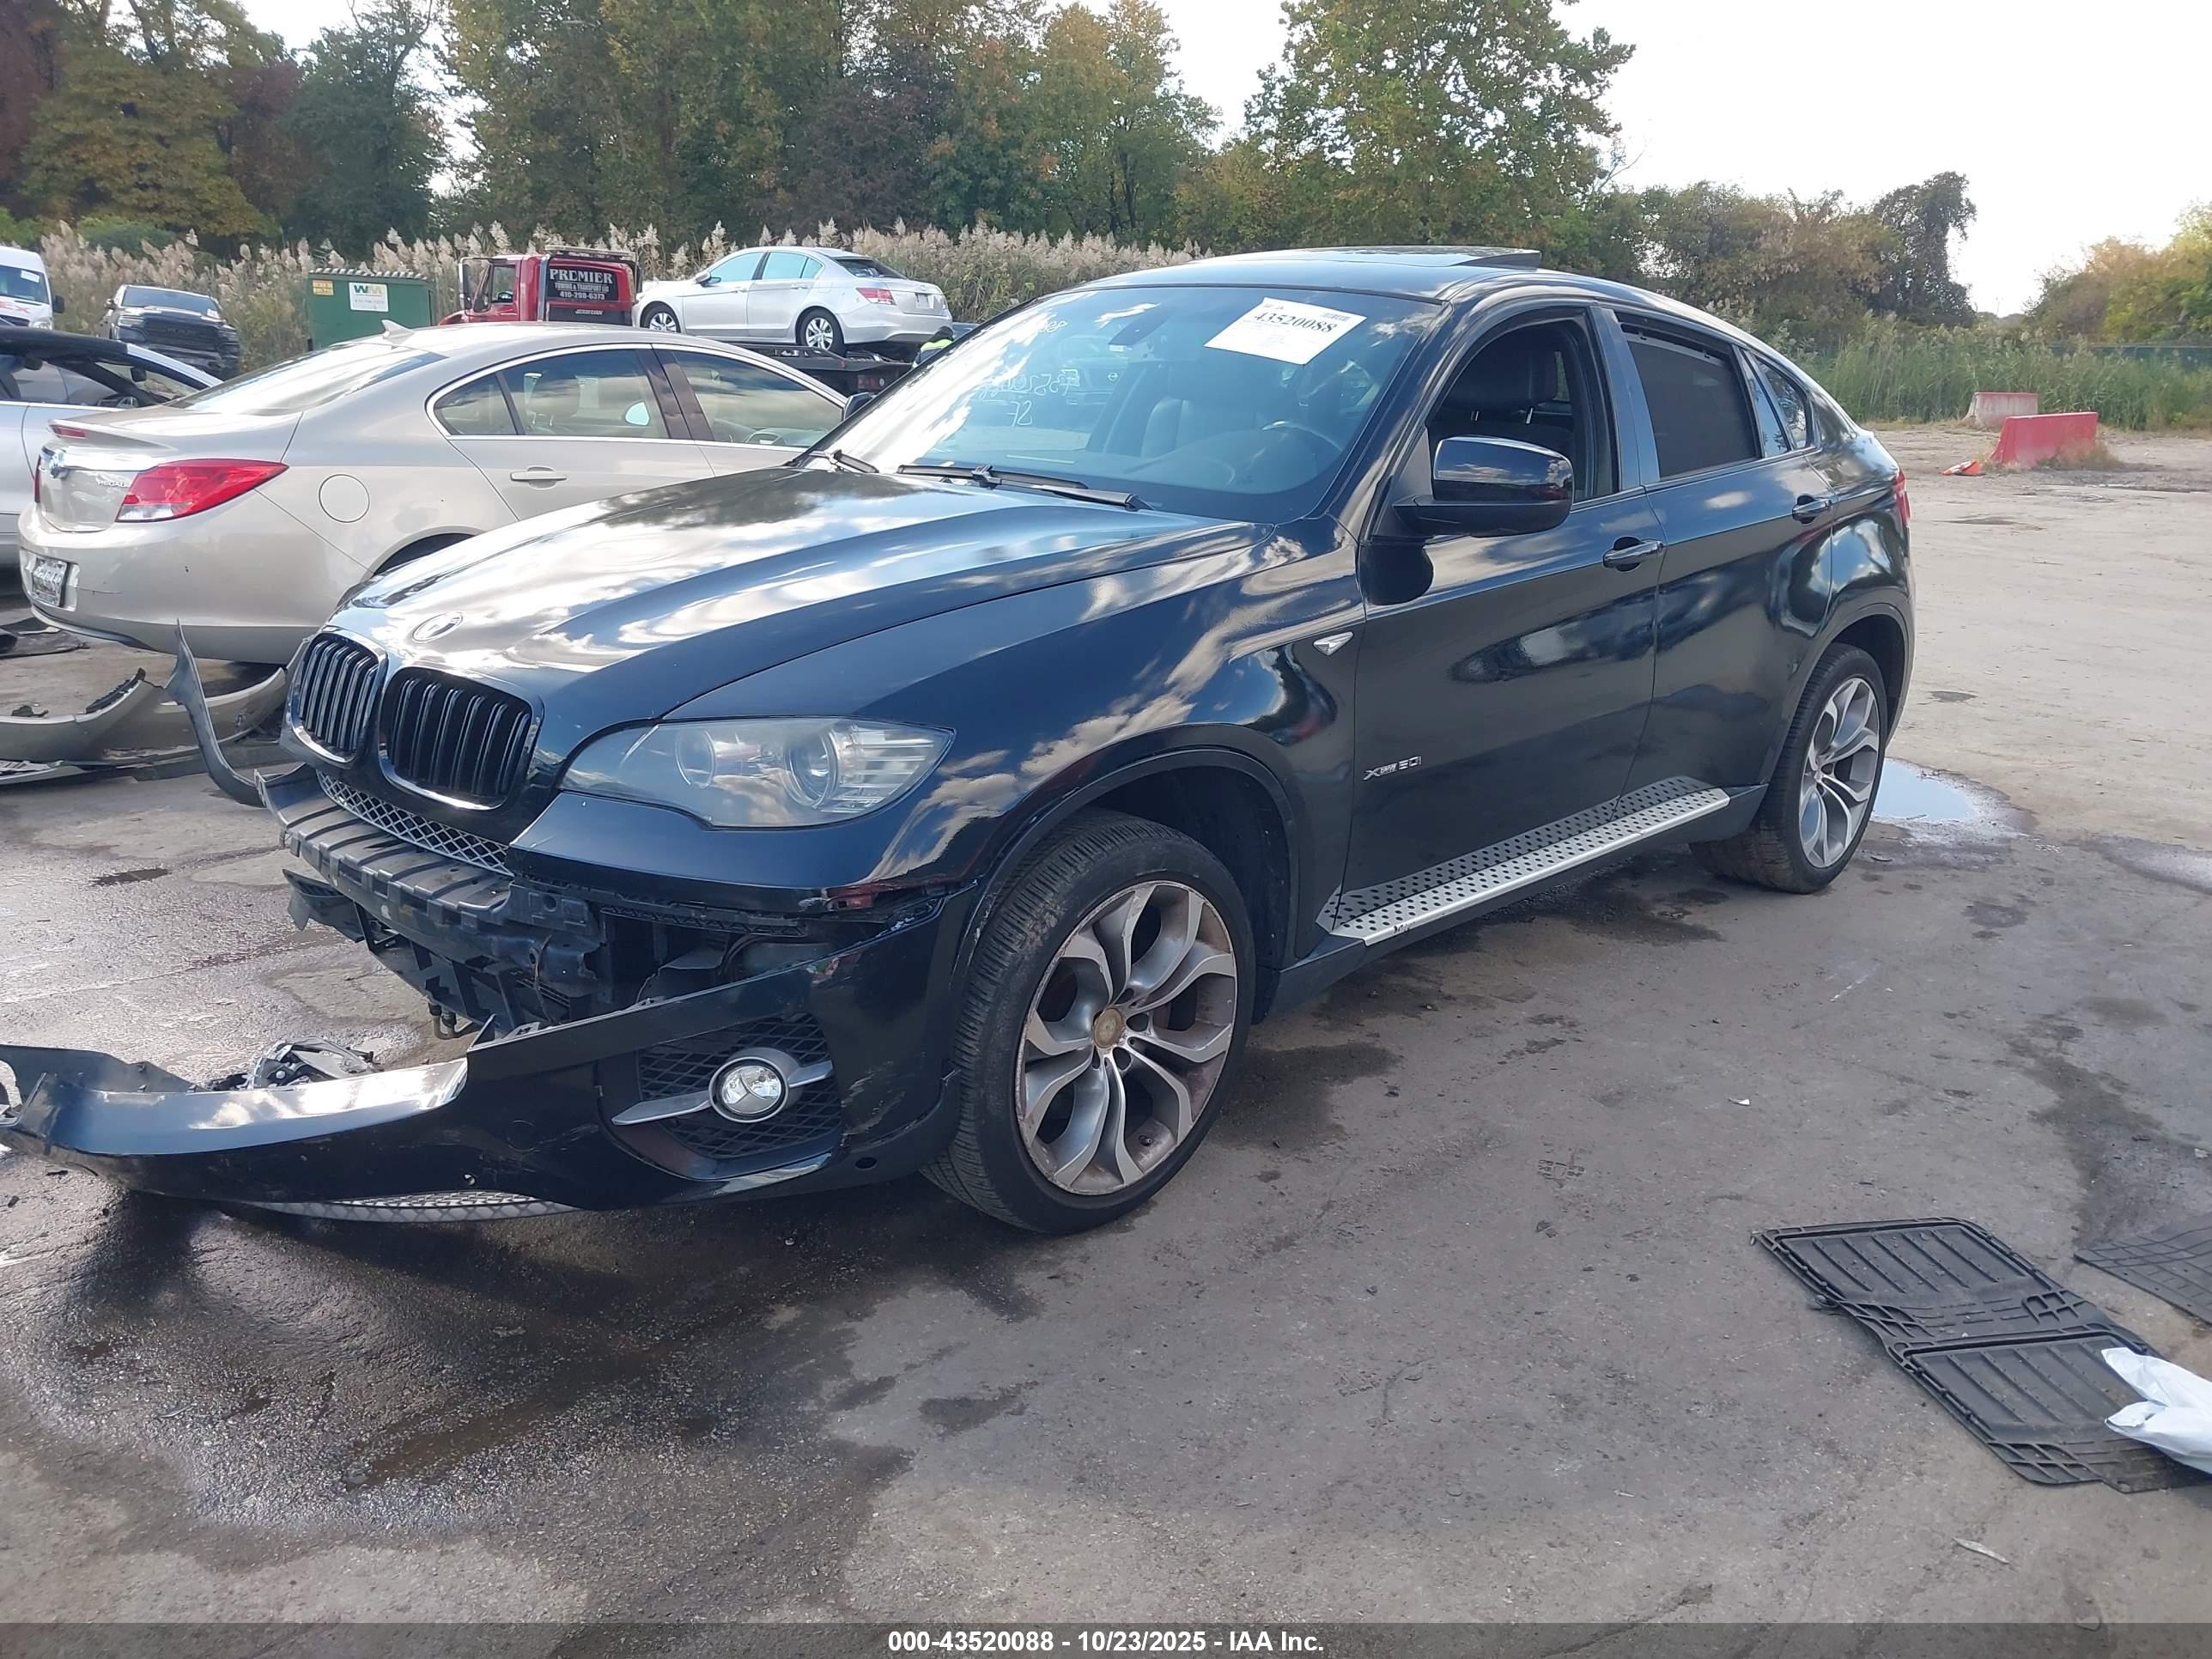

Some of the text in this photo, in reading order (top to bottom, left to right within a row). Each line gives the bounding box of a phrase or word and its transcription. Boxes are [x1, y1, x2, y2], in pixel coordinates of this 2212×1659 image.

[550, 268, 612, 283] PREMIER
[354, 285, 382, 295] WM
[1254, 311, 1338, 333] 43520088
